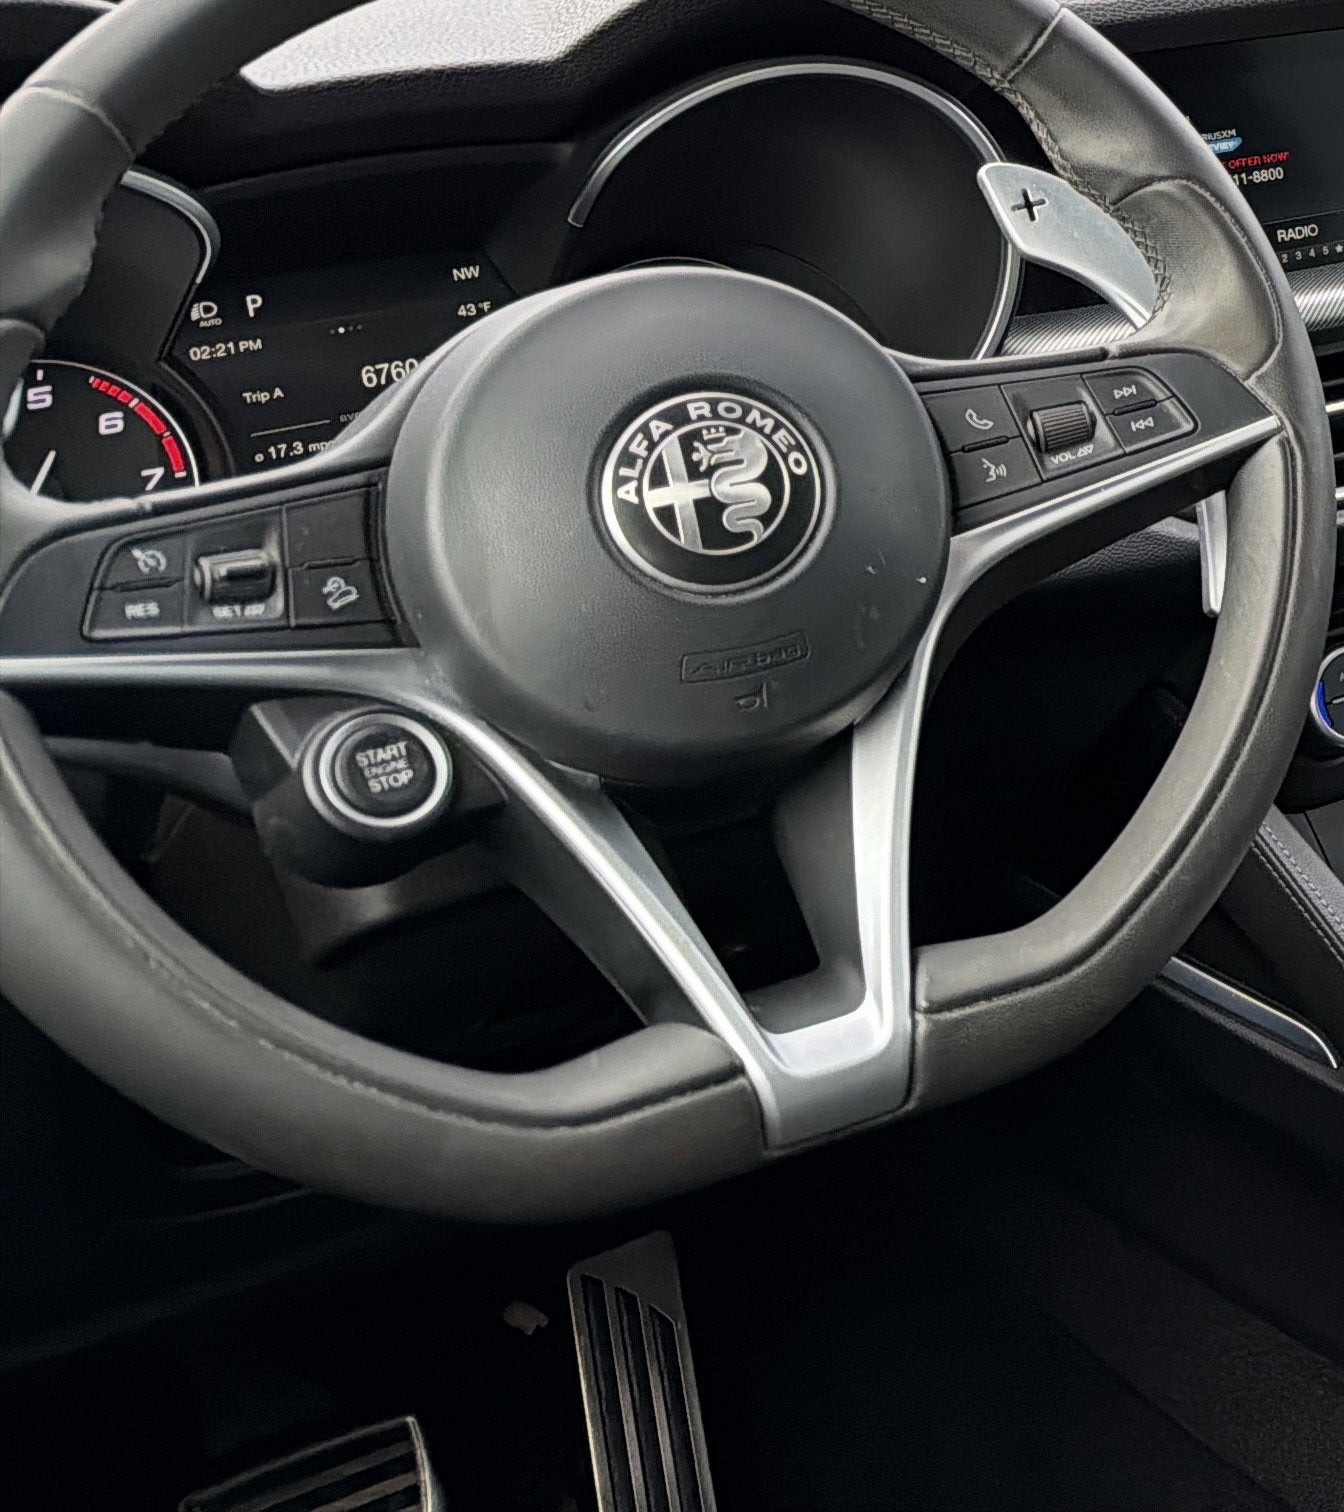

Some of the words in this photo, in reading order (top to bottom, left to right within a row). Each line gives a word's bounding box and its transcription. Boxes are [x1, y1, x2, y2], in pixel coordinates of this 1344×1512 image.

[1231, 167, 1285, 186] 11-8800
[1276, 223, 1319, 242] RADIO
[1281, 253, 1289, 263] 2
[1295, 251, 1302, 260] 3
[1308, 249, 1316, 258] 4
[1322, 246, 1329, 255] 5
[452, 265, 480, 281] NW
[246, 294, 263, 318] P
[457, 303, 477, 317] 43
[199, 317, 223, 328] AUTO
[189, 341, 235, 361] 02:21
[238, 338, 263, 352] PM
[26, 386, 53, 410] 5
[242, 390, 270, 405] Trip
[272, 387, 285, 399] A
[98, 411, 125, 435] 6
[268, 441, 304, 461] 17.3
[617, 419, 673, 505] ALFA
[686, 400, 808, 476] ROMEO
[1051, 453, 1076, 465] VOL
[140, 467, 165, 491] 7
[355, 740, 408, 768] START
[363, 758, 410, 779] ENGINE
[367, 769, 414, 794] STOP
